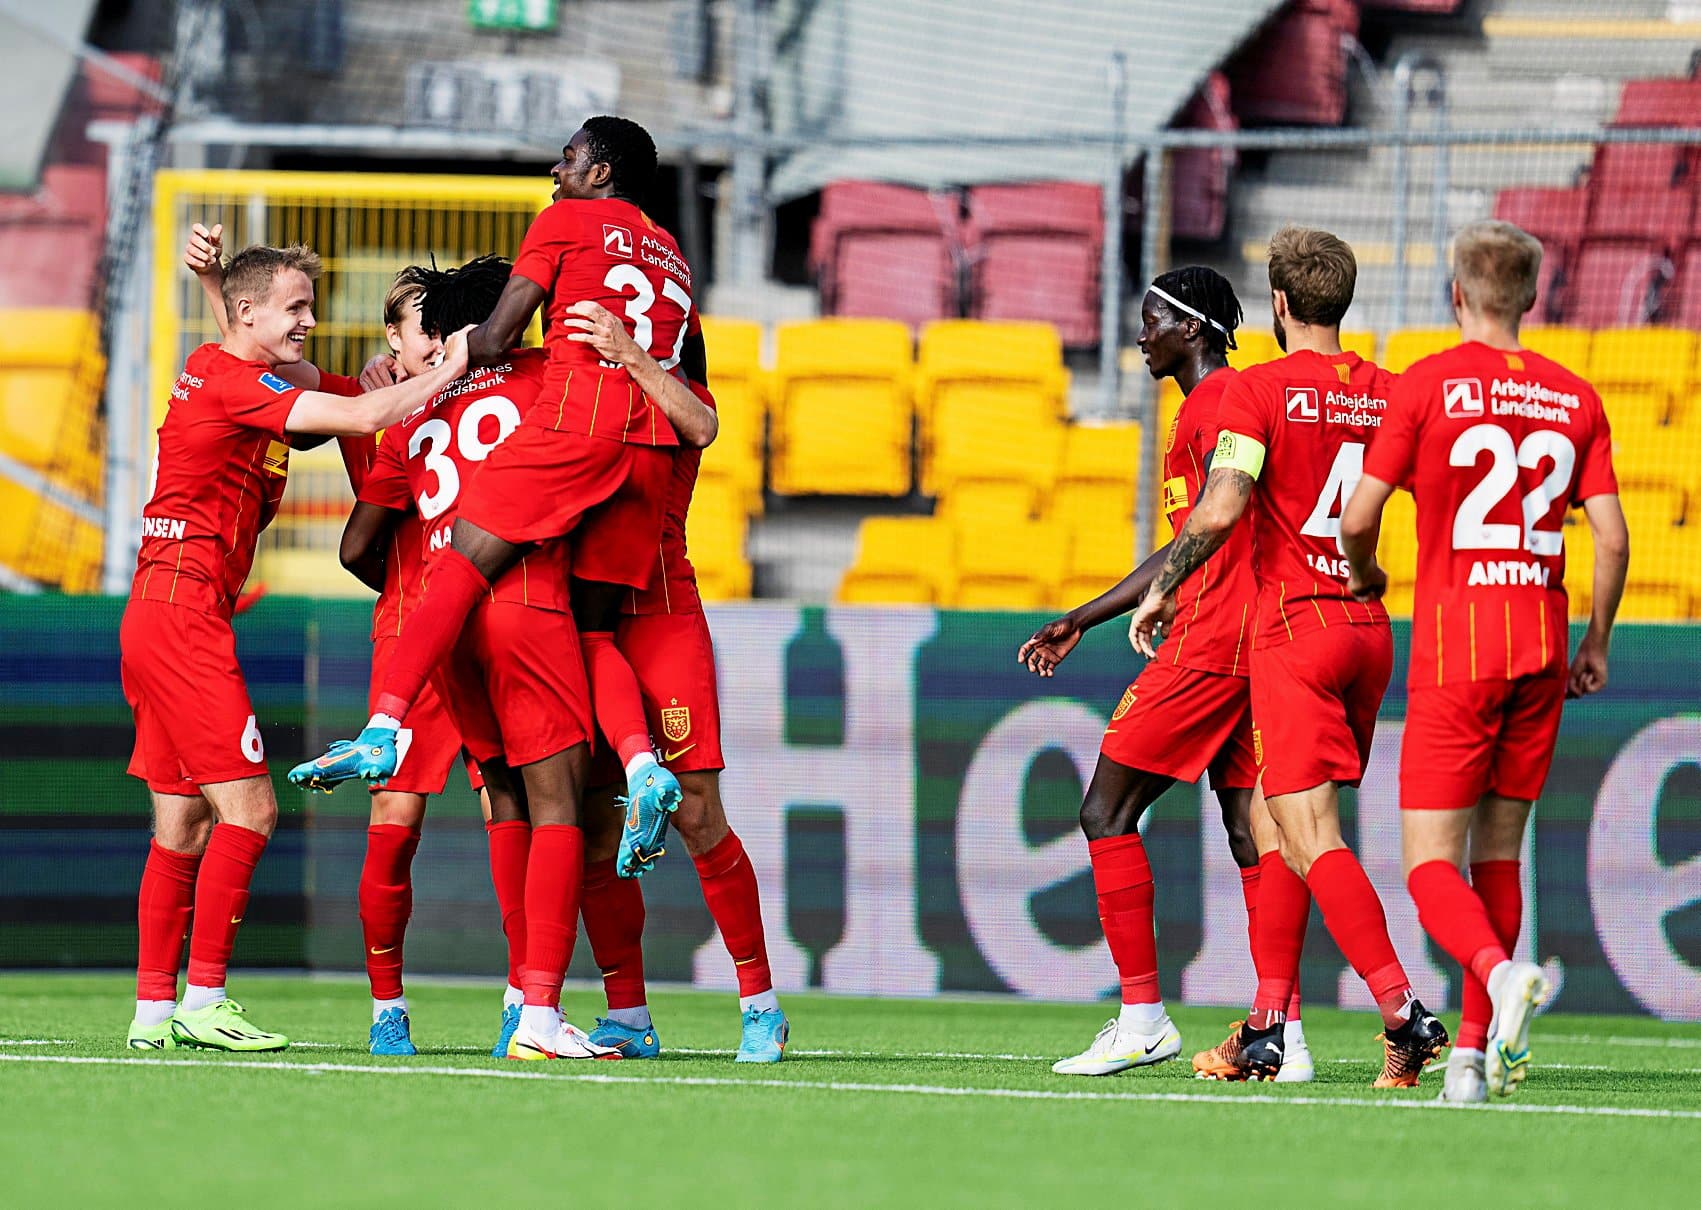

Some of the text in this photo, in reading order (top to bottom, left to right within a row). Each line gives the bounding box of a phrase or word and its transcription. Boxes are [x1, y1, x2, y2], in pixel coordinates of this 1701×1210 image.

[604, 264, 692, 370] 37
[432, 372, 506, 408] Landsbank
[1325, 390, 1387, 413] Arbejdern
[1490, 377, 1580, 409] Arbejdernes
[1491, 396, 1571, 425] Landsbank
[1299, 441, 1366, 556] 4
[1449, 423, 1576, 556] 22
[142, 516, 187, 540] NSEN
[1467, 560, 1550, 590] ANTM
[241, 714, 264, 764] 6
